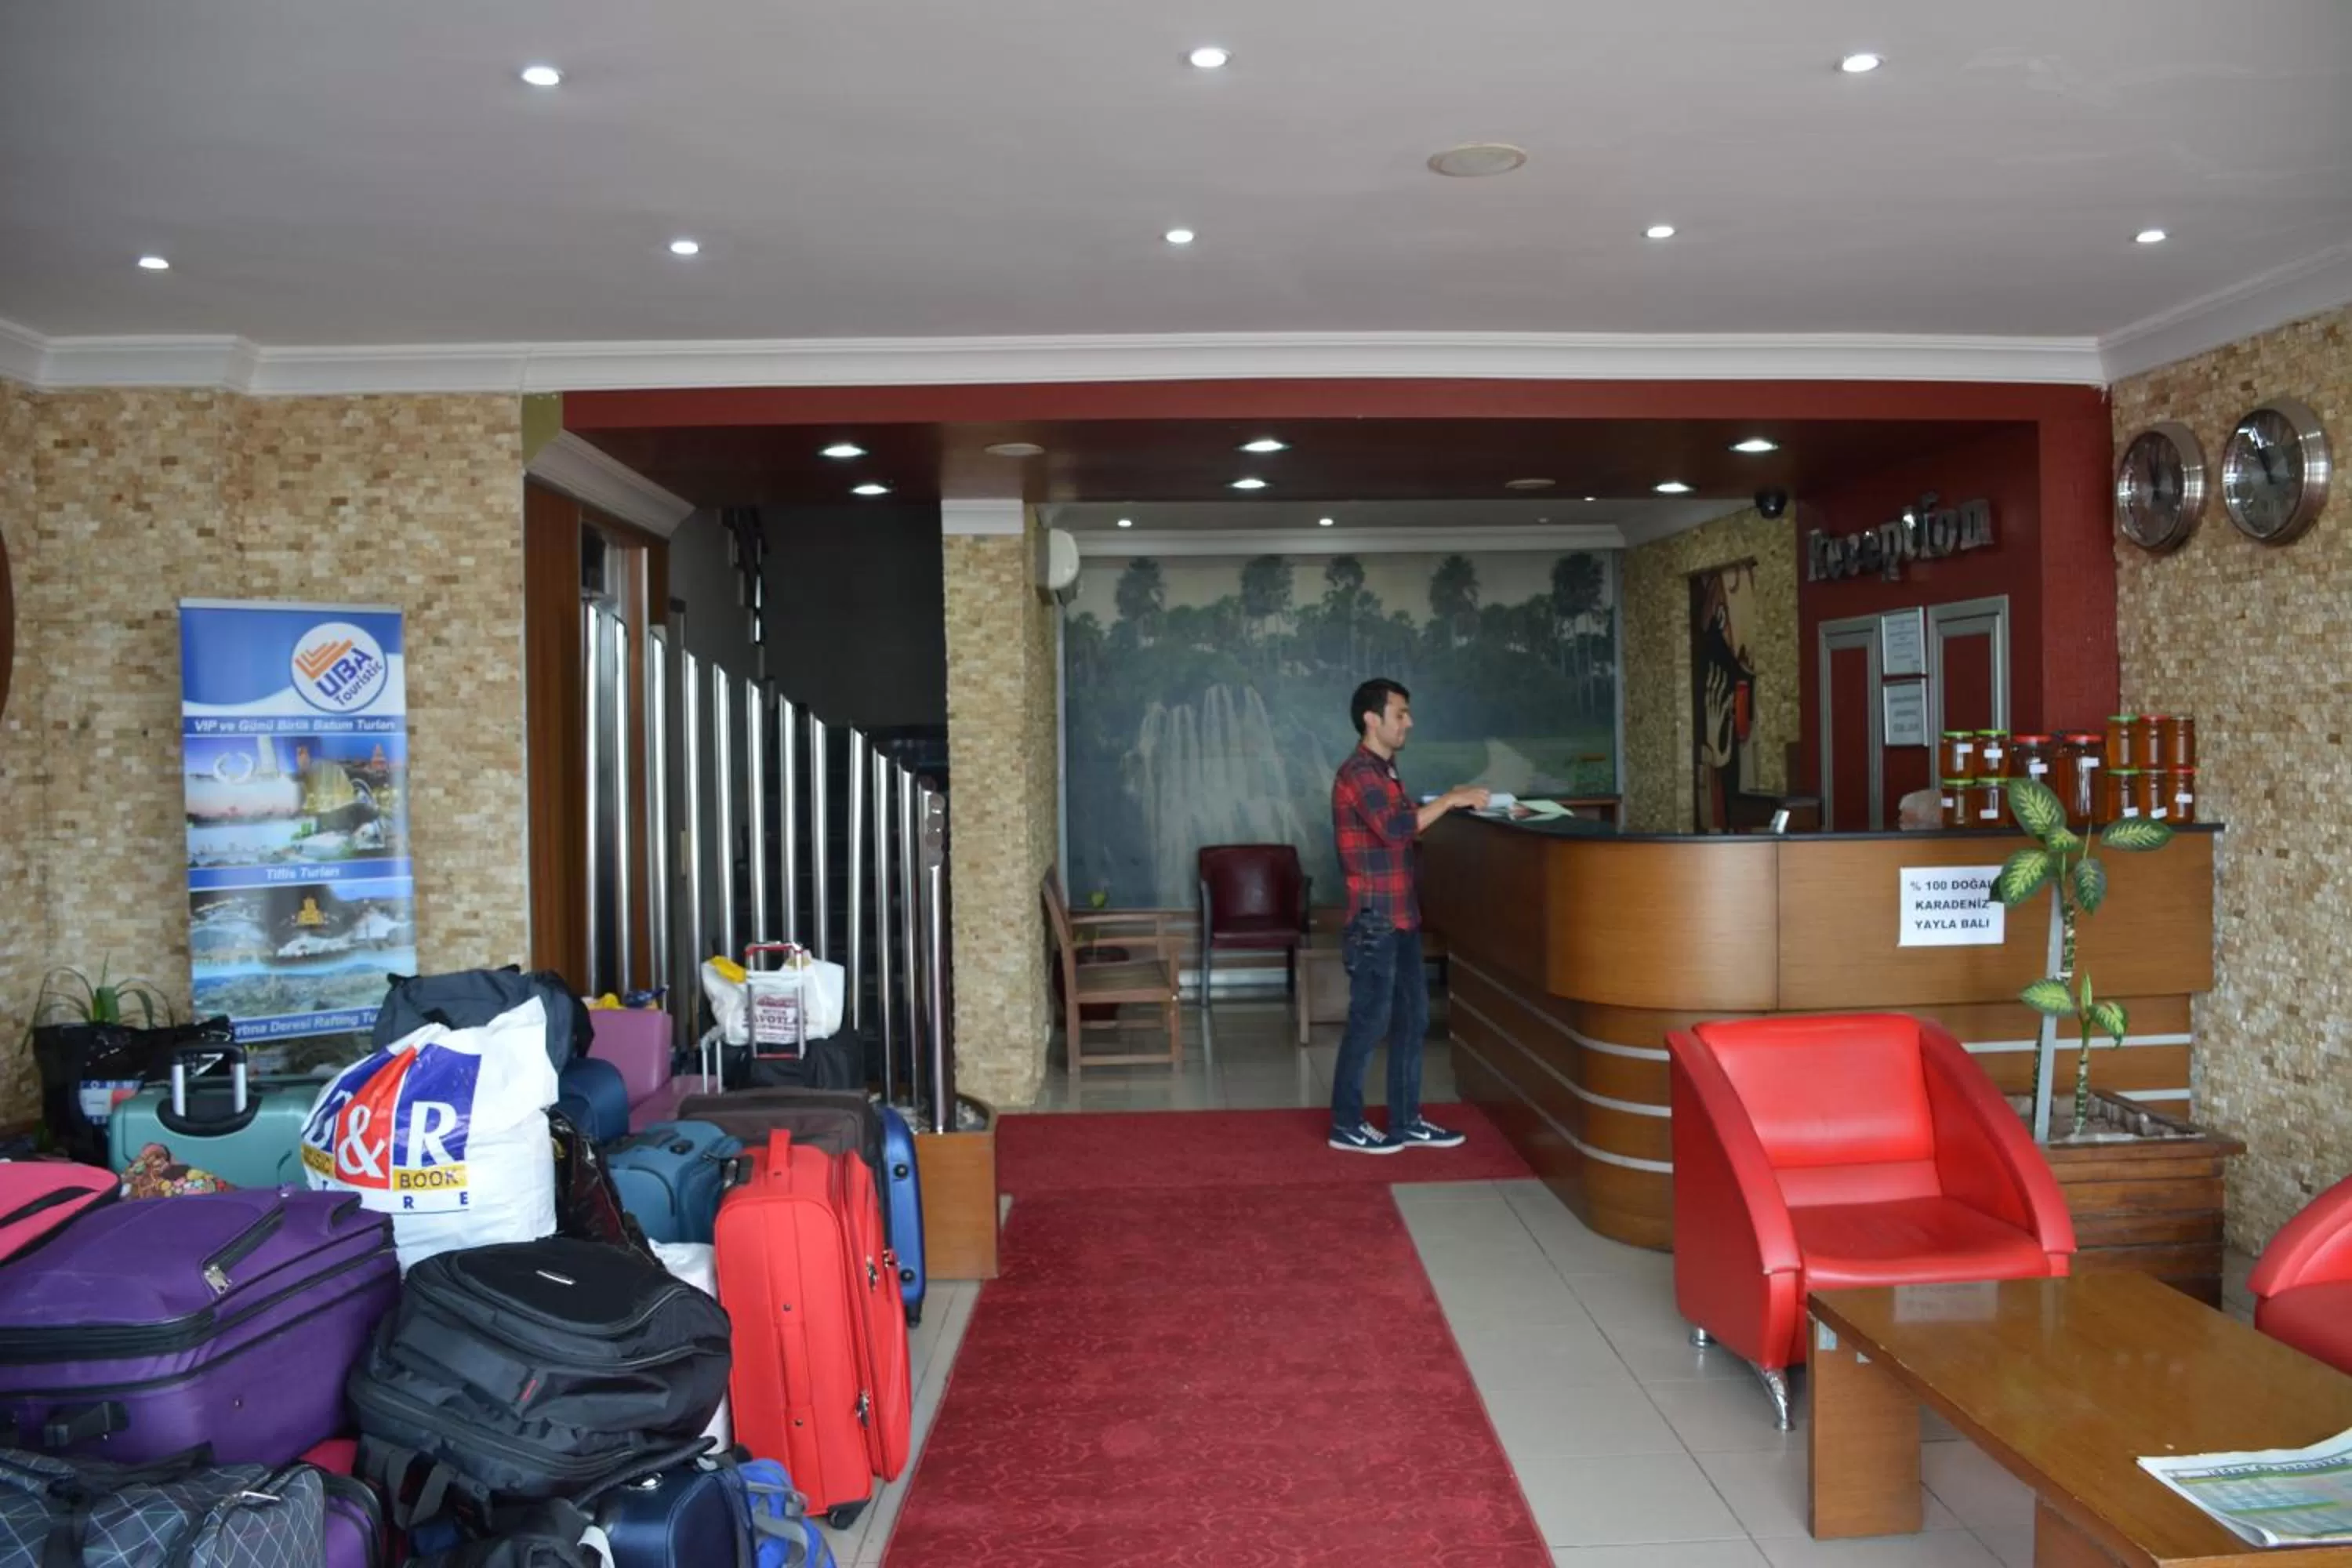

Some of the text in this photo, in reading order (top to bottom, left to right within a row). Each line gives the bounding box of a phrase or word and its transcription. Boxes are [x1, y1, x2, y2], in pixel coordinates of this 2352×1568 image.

[315, 648, 373, 697] UBA
[332, 660, 383, 706] Touristic
[194, 719, 218, 732] VIP
[1926, 880, 1947, 891] 100
[1915, 898, 1990, 910] KARADENİZ
[1915, 918, 1990, 929] YAYLA BALI
[400, 1171, 459, 1189] BOOK
